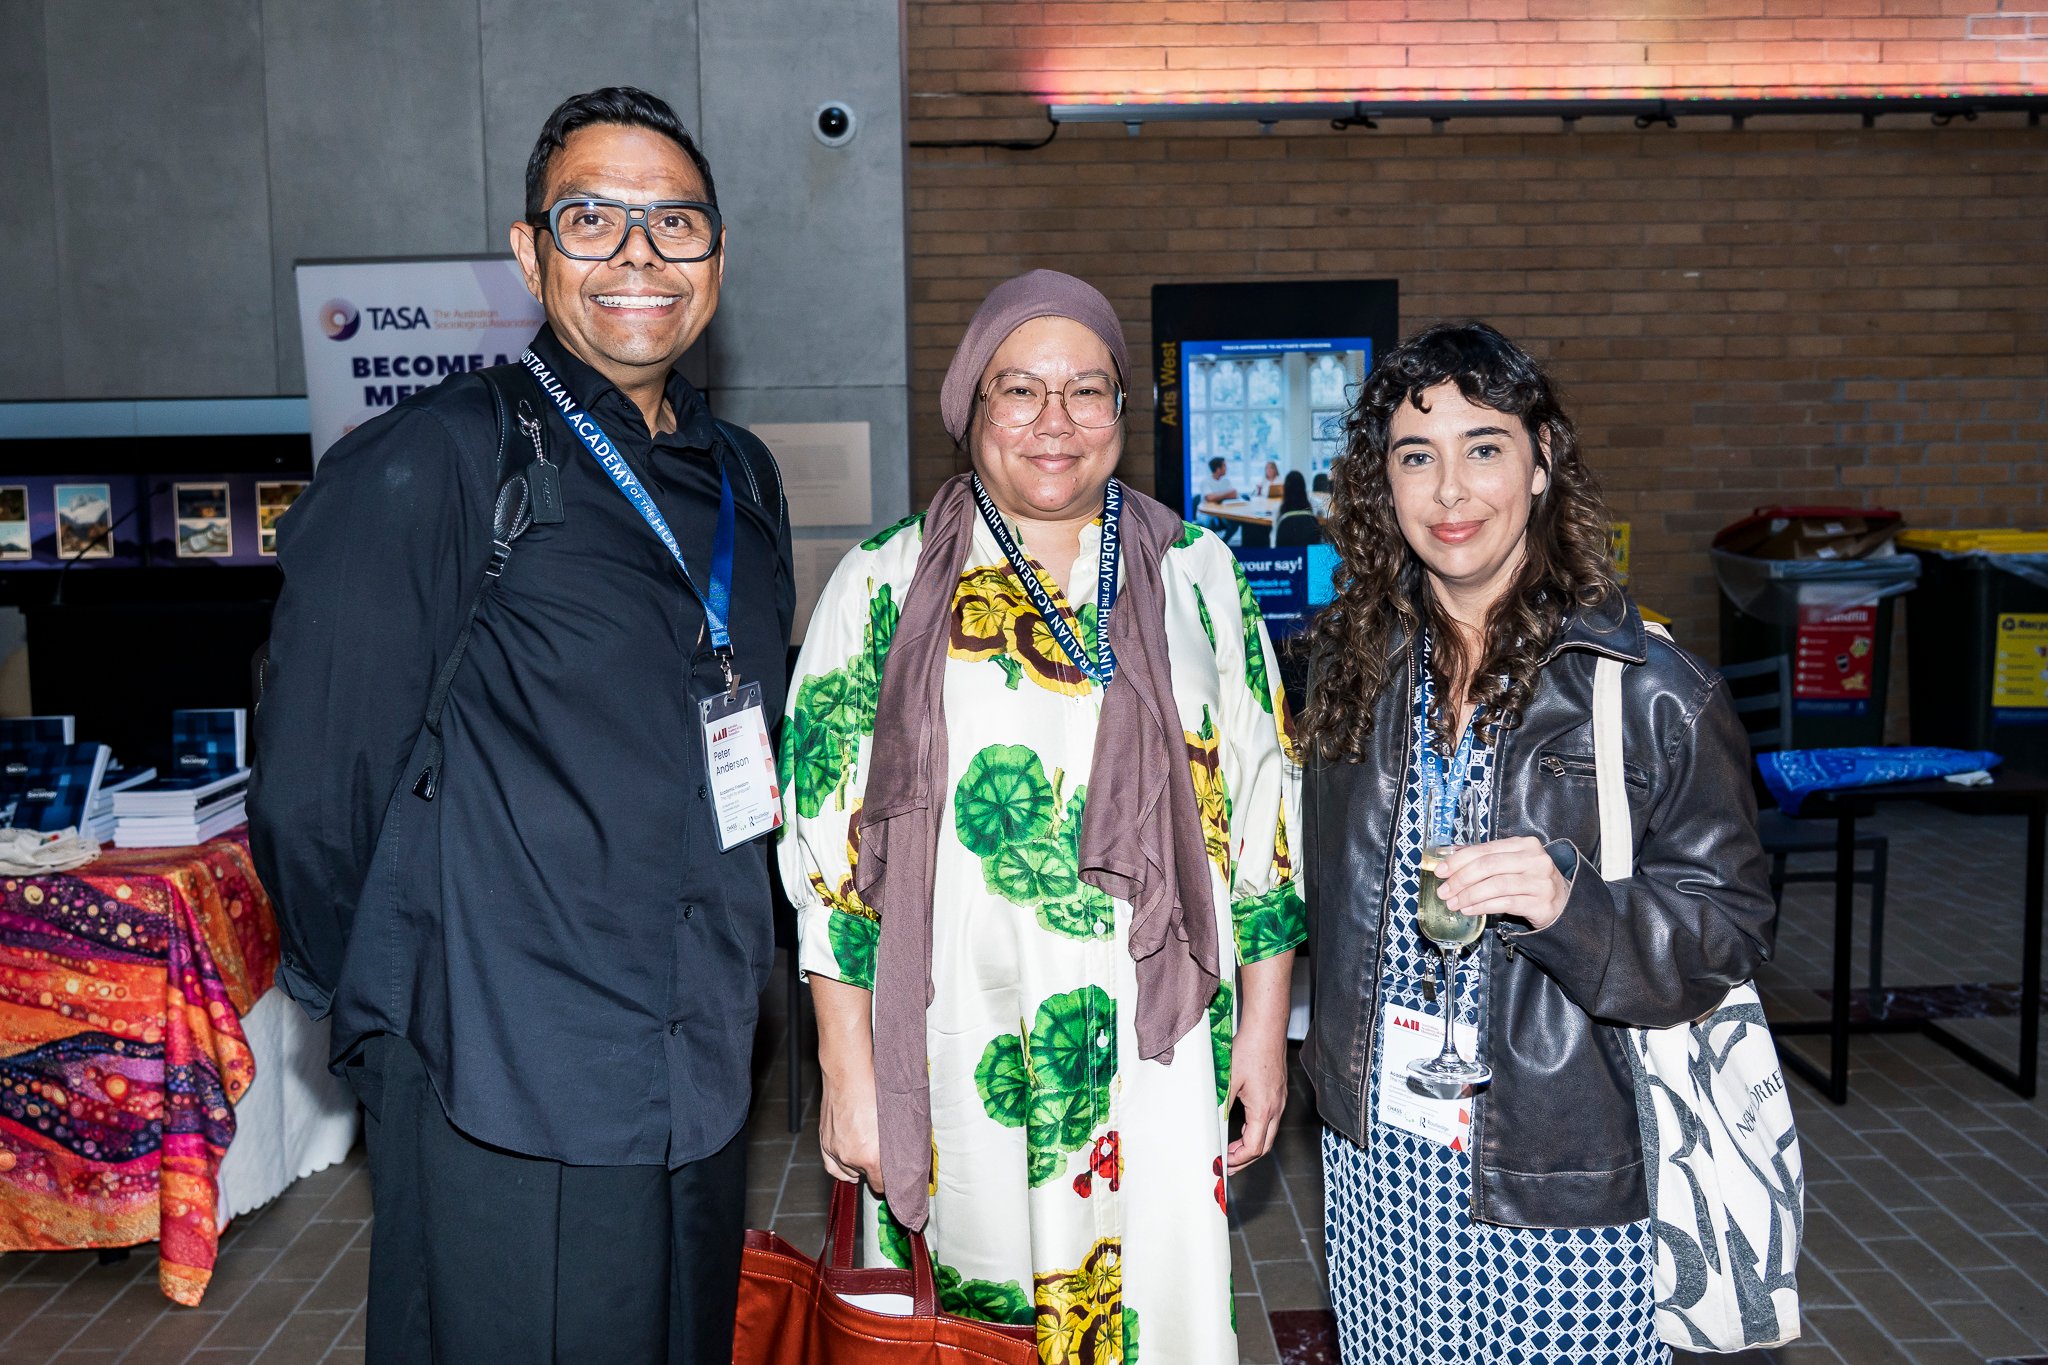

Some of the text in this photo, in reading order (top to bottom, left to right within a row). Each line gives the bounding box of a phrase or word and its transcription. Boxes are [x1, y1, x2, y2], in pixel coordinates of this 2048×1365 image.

[366, 306, 430, 330] TASA
[352, 354, 484, 378] BECOME
[364, 384, 429, 407] ME
[1160, 342, 1177, 426] Arts West
[521, 348, 576, 413] USTRALIAN
[568, 413, 635, 487] ACADEMY
[630, 487, 642, 499] OF
[640, 499, 655, 519] THE
[1101, 513, 1117, 582] ACADEMY
[974, 474, 1099, 677] TRALIAN ACADEMY OF THE HUMANIT
[1239, 556, 1302, 574] your say!
[1102, 581, 1110, 592] OF
[1102, 593, 1110, 607] THE
[713, 748, 730, 762] Peter
[716, 756, 750, 776] Anderson
[1427, 756, 1436, 769] OF
[1427, 770, 1436, 786] TH
[1735, 1067, 1784, 1139] NEW ORKE
